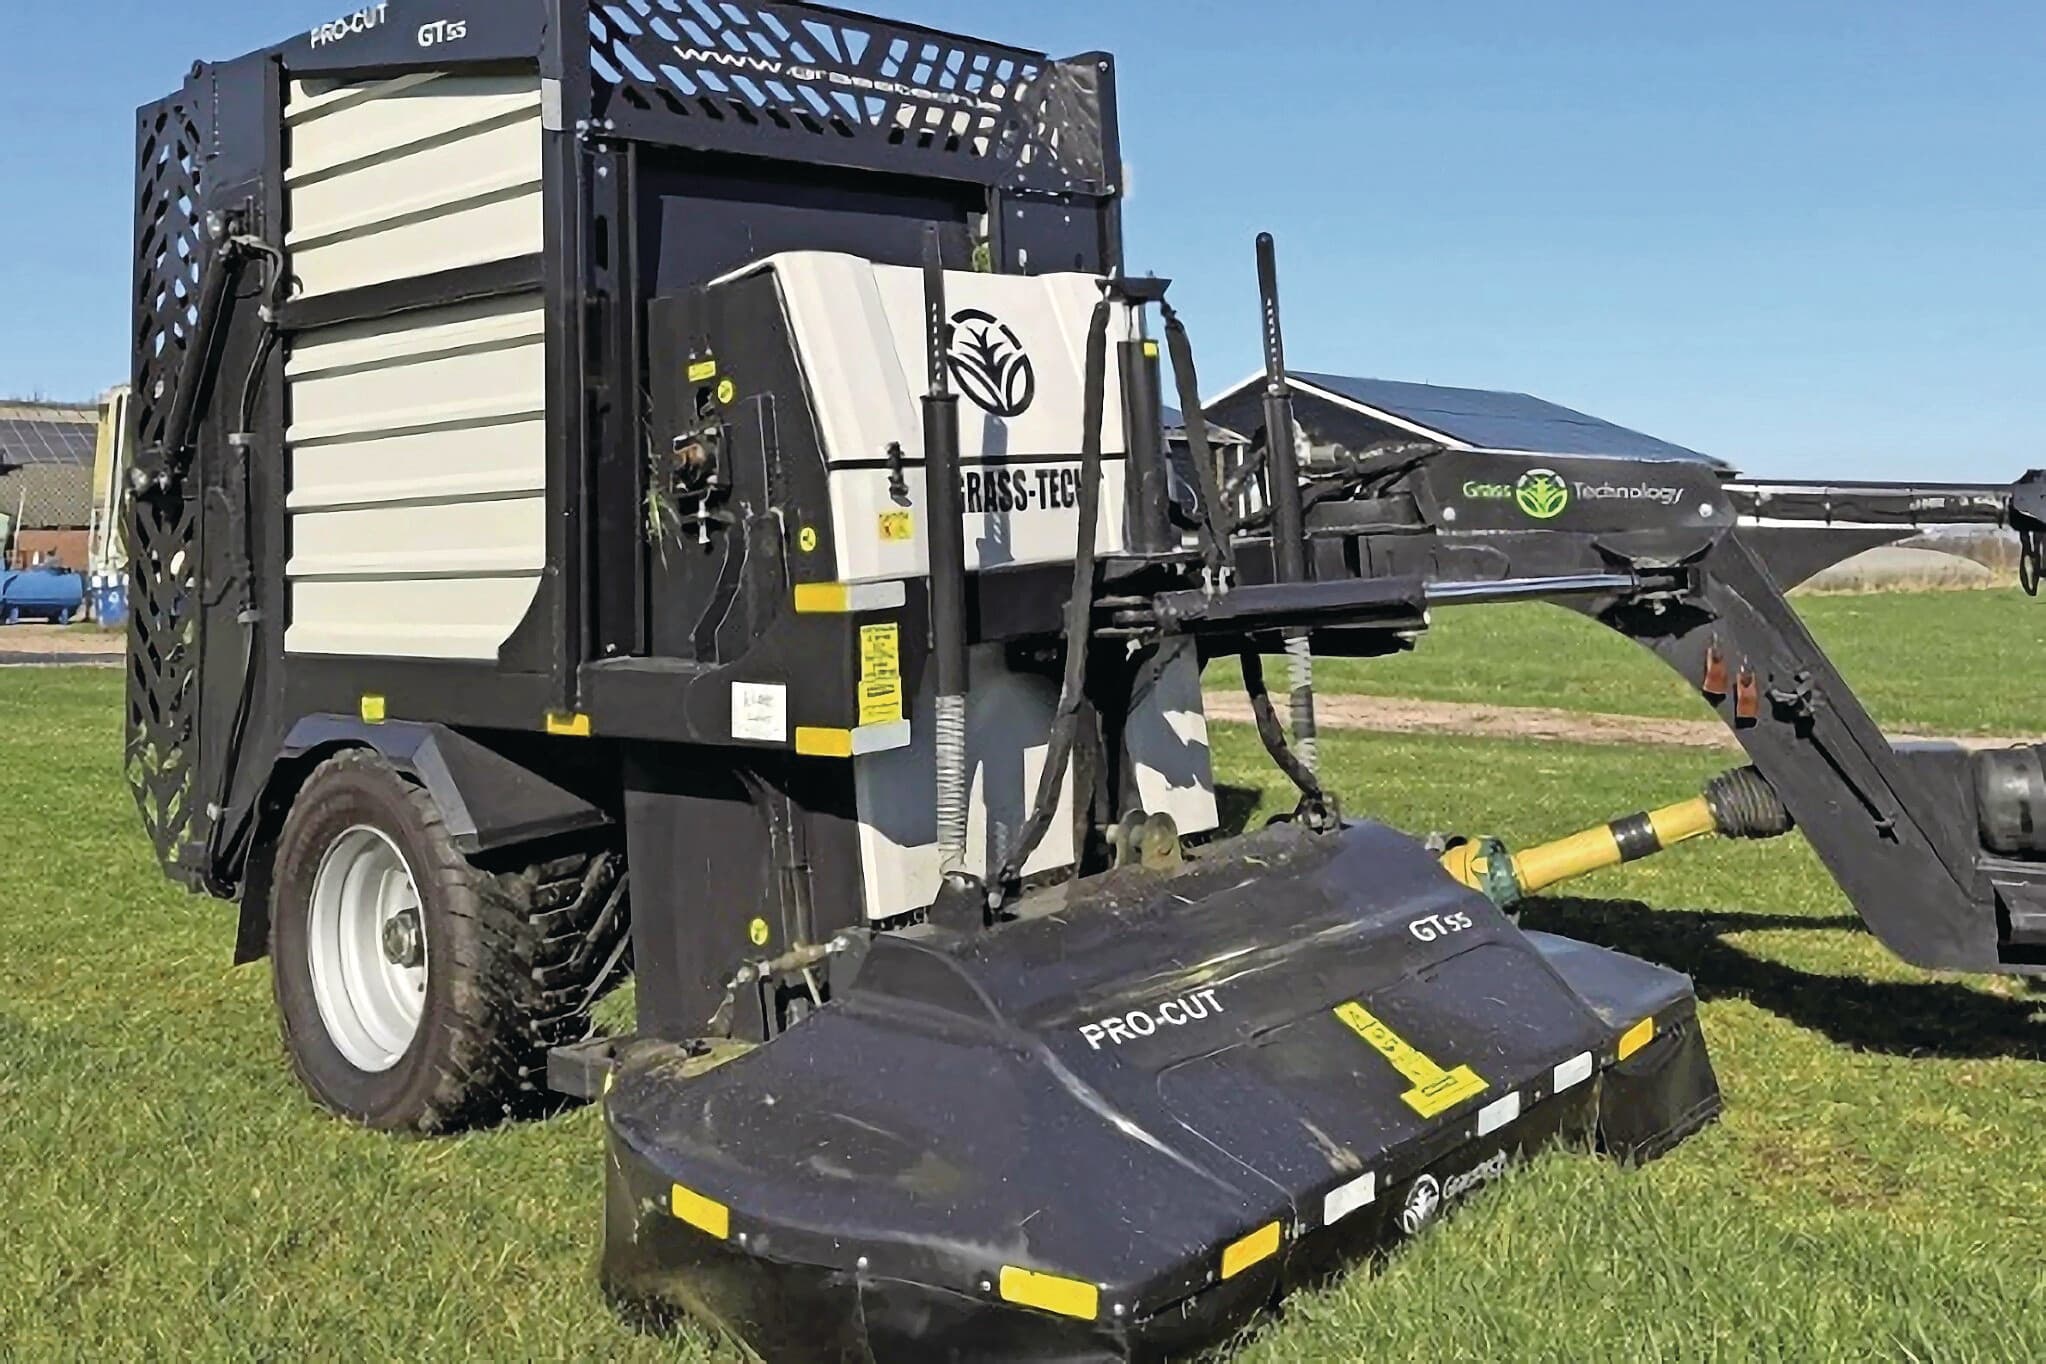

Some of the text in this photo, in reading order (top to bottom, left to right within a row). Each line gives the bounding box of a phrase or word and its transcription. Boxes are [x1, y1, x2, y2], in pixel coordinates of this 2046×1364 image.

[960, 468, 1082, 514] RASS-TEC
[1463, 480, 1685, 505] Grass Technology
[1079, 989, 1226, 1051] PRO-CUT
